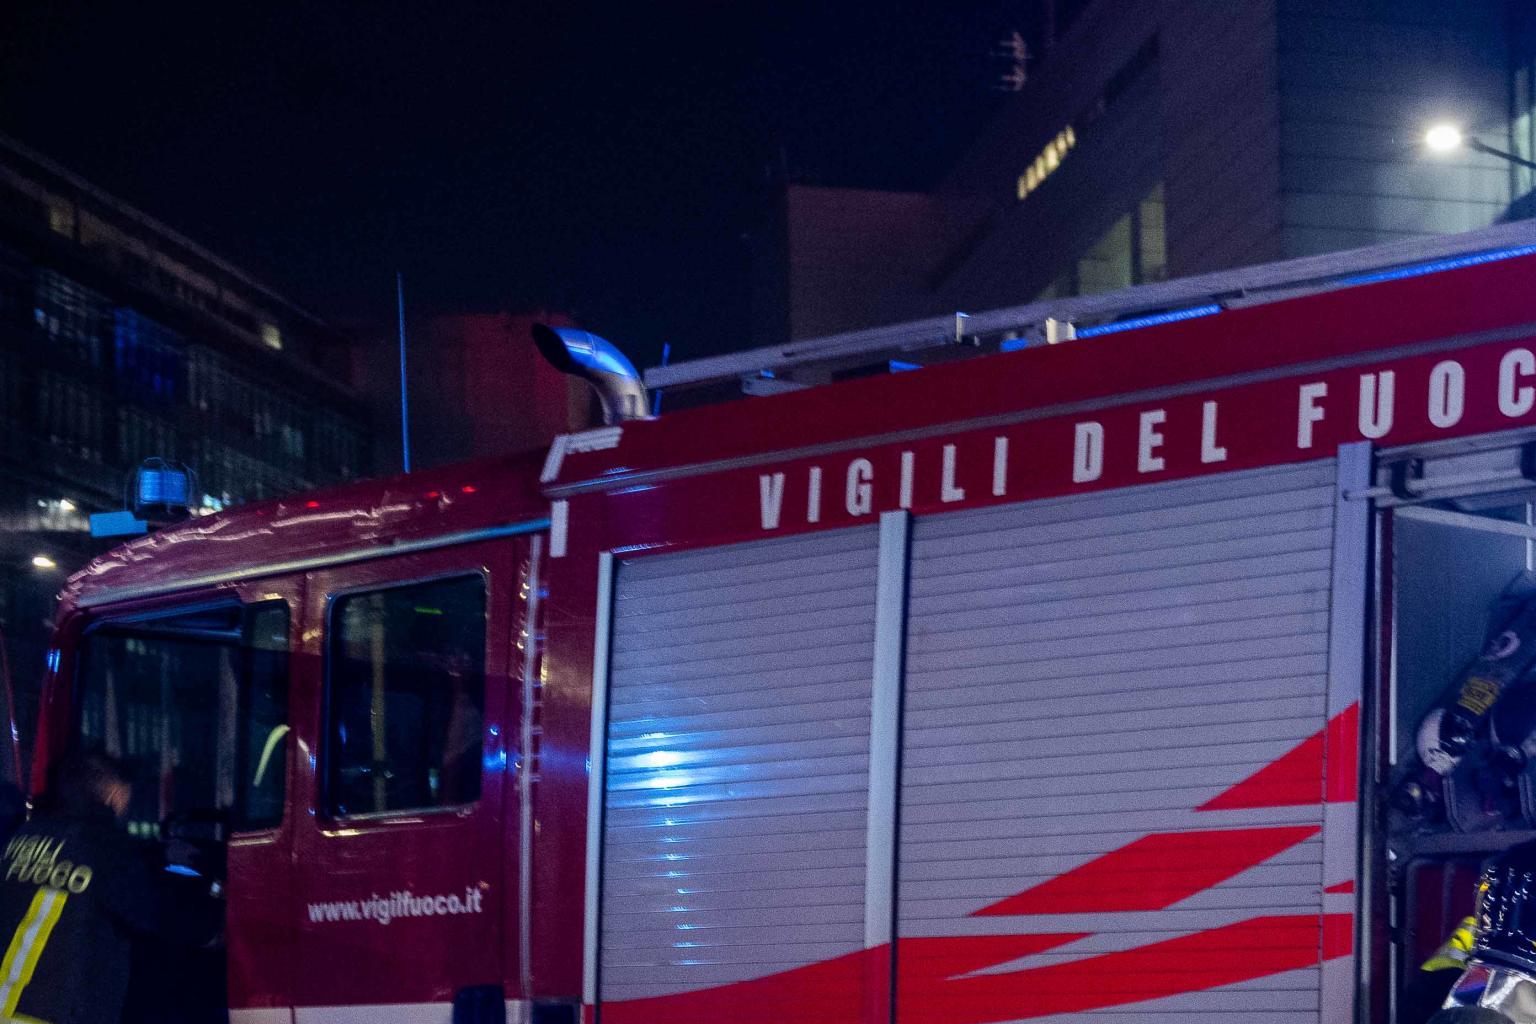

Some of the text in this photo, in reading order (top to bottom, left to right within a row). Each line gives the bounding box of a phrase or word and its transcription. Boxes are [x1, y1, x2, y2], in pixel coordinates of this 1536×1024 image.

[759, 436, 1009, 530] VIGILI
[1072, 401, 1228, 484] DEL
[307, 886, 473, 925] www.vigilfuoco.it
